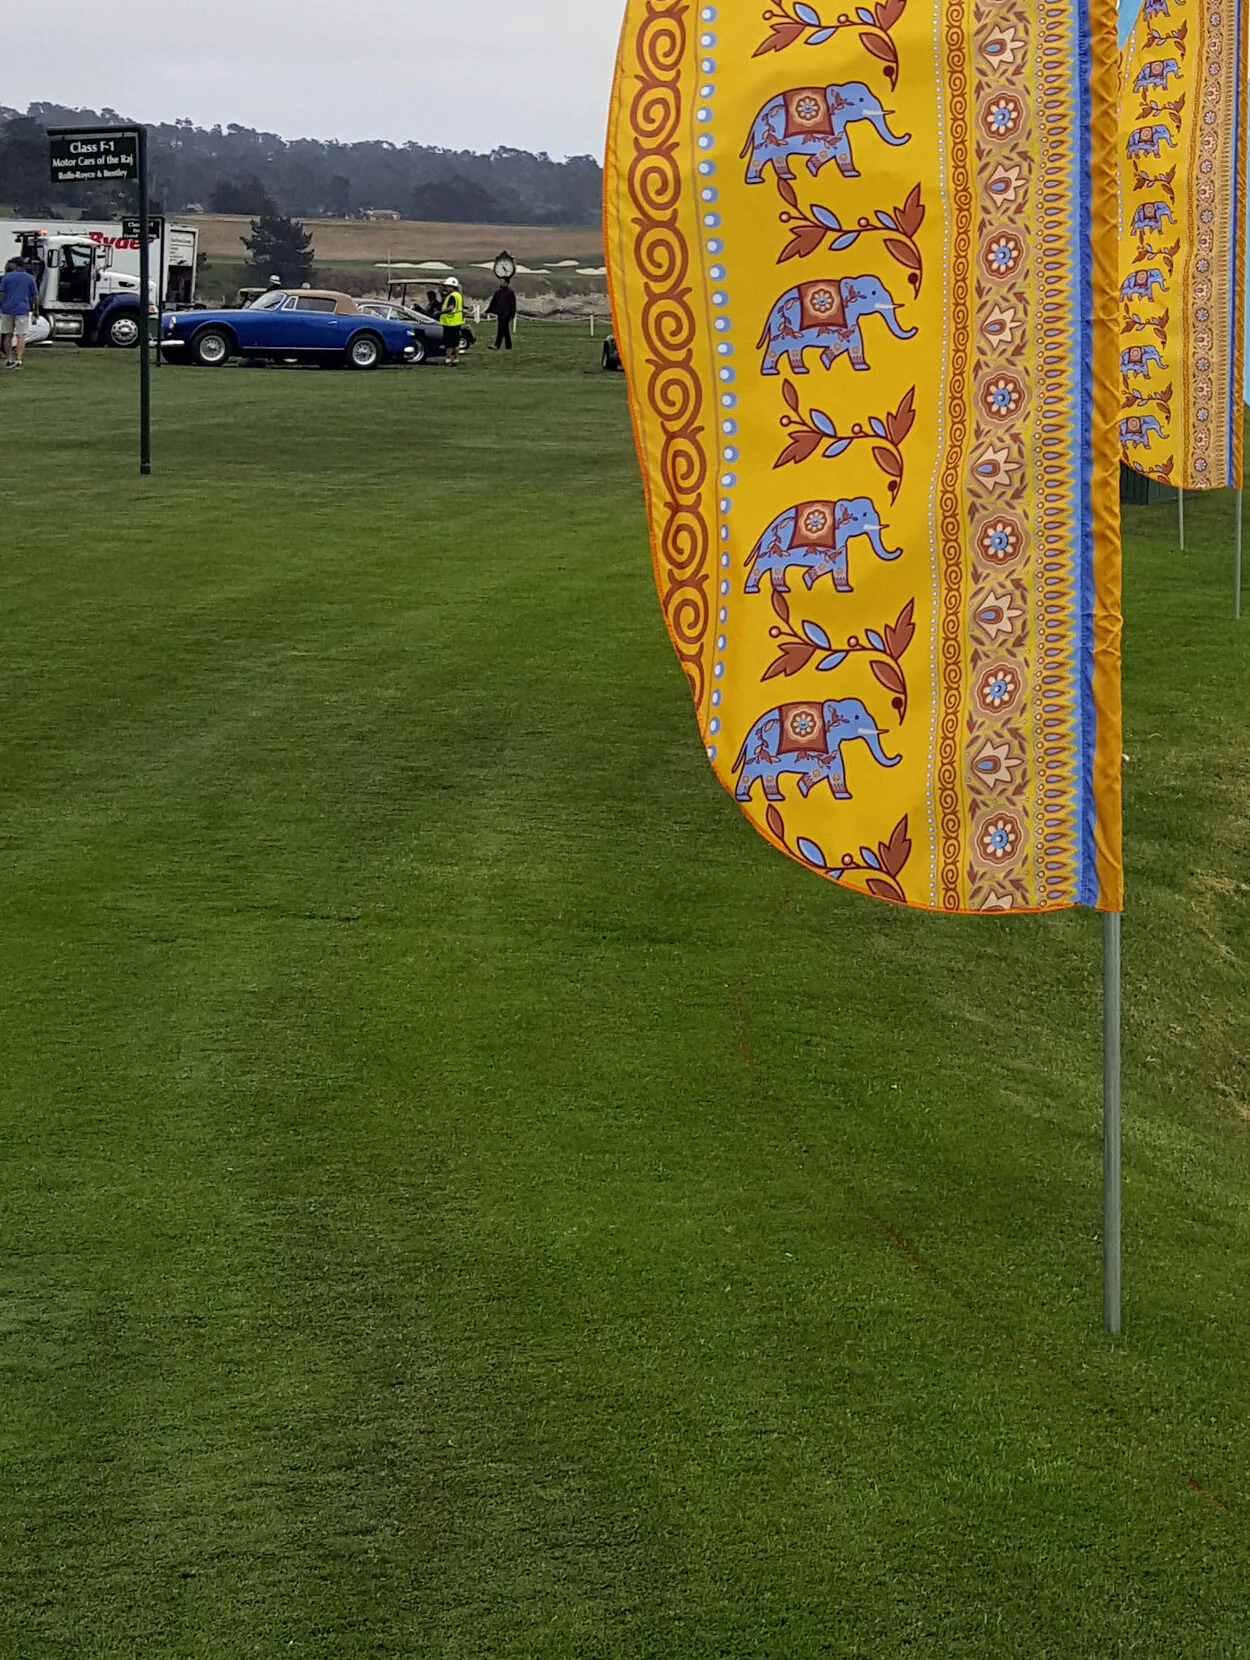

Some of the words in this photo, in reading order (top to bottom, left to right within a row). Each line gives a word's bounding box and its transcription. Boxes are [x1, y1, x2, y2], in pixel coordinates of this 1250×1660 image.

[70, 141, 97, 153] Class
[100, 141, 115, 152] F-1
[52, 158, 76, 167] Motor
[78, 157, 95, 166] Cars
[97, 154, 105, 164] of
[107, 155, 119, 164] the
[121, 154, 133, 166] Raj
[58, 171, 96, 180] Rolls-Royce
[103, 168, 127, 179] Bentley
